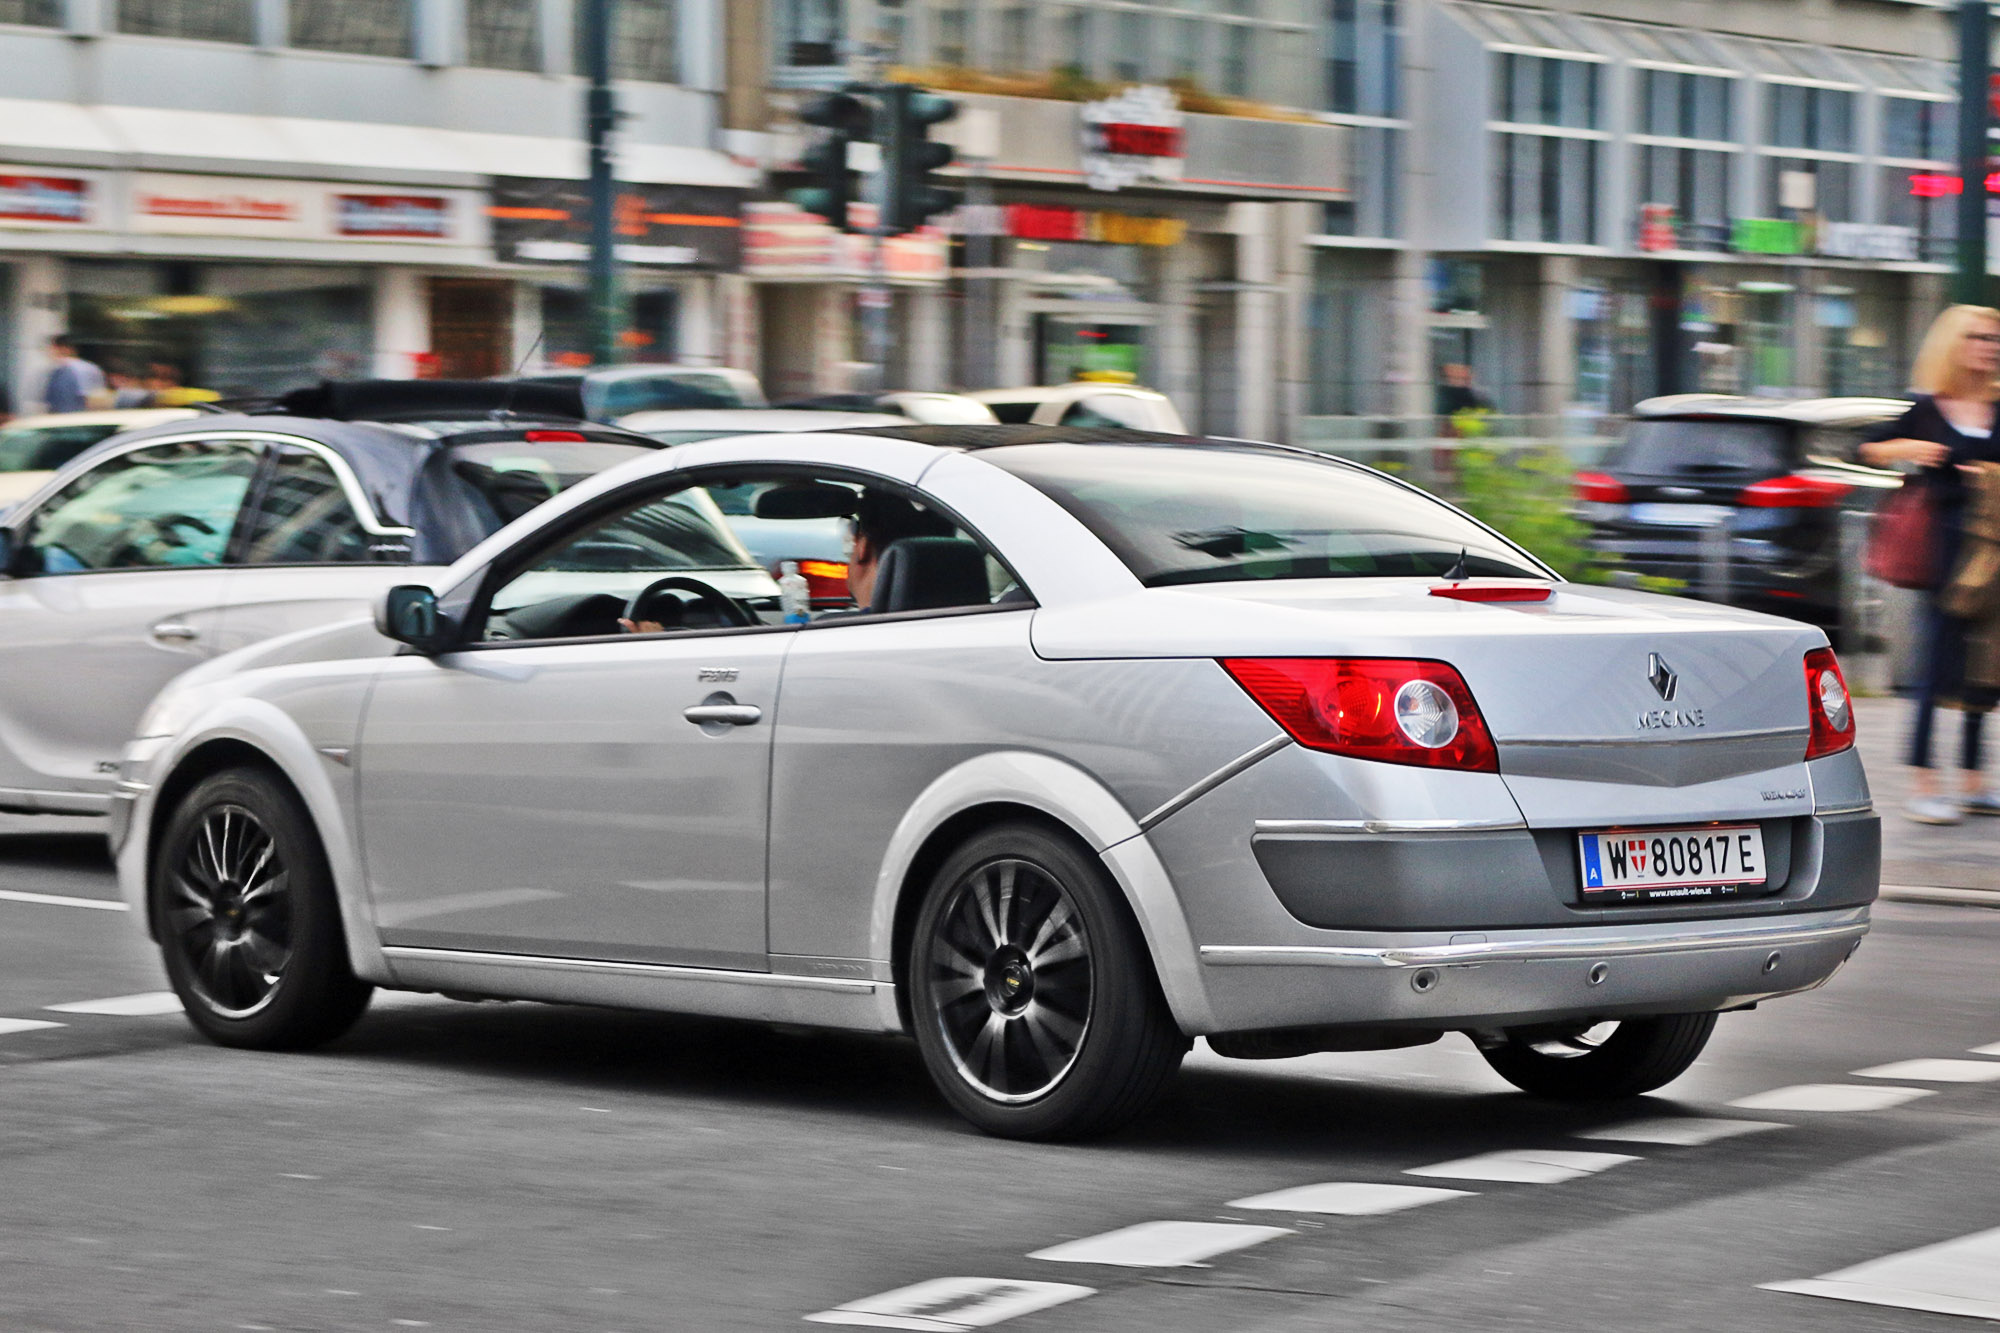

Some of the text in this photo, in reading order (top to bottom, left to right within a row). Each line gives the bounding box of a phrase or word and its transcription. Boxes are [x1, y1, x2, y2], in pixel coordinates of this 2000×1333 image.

[1607, 834, 1755, 879] W 80817 E
[1590, 868, 1598, 880] A
